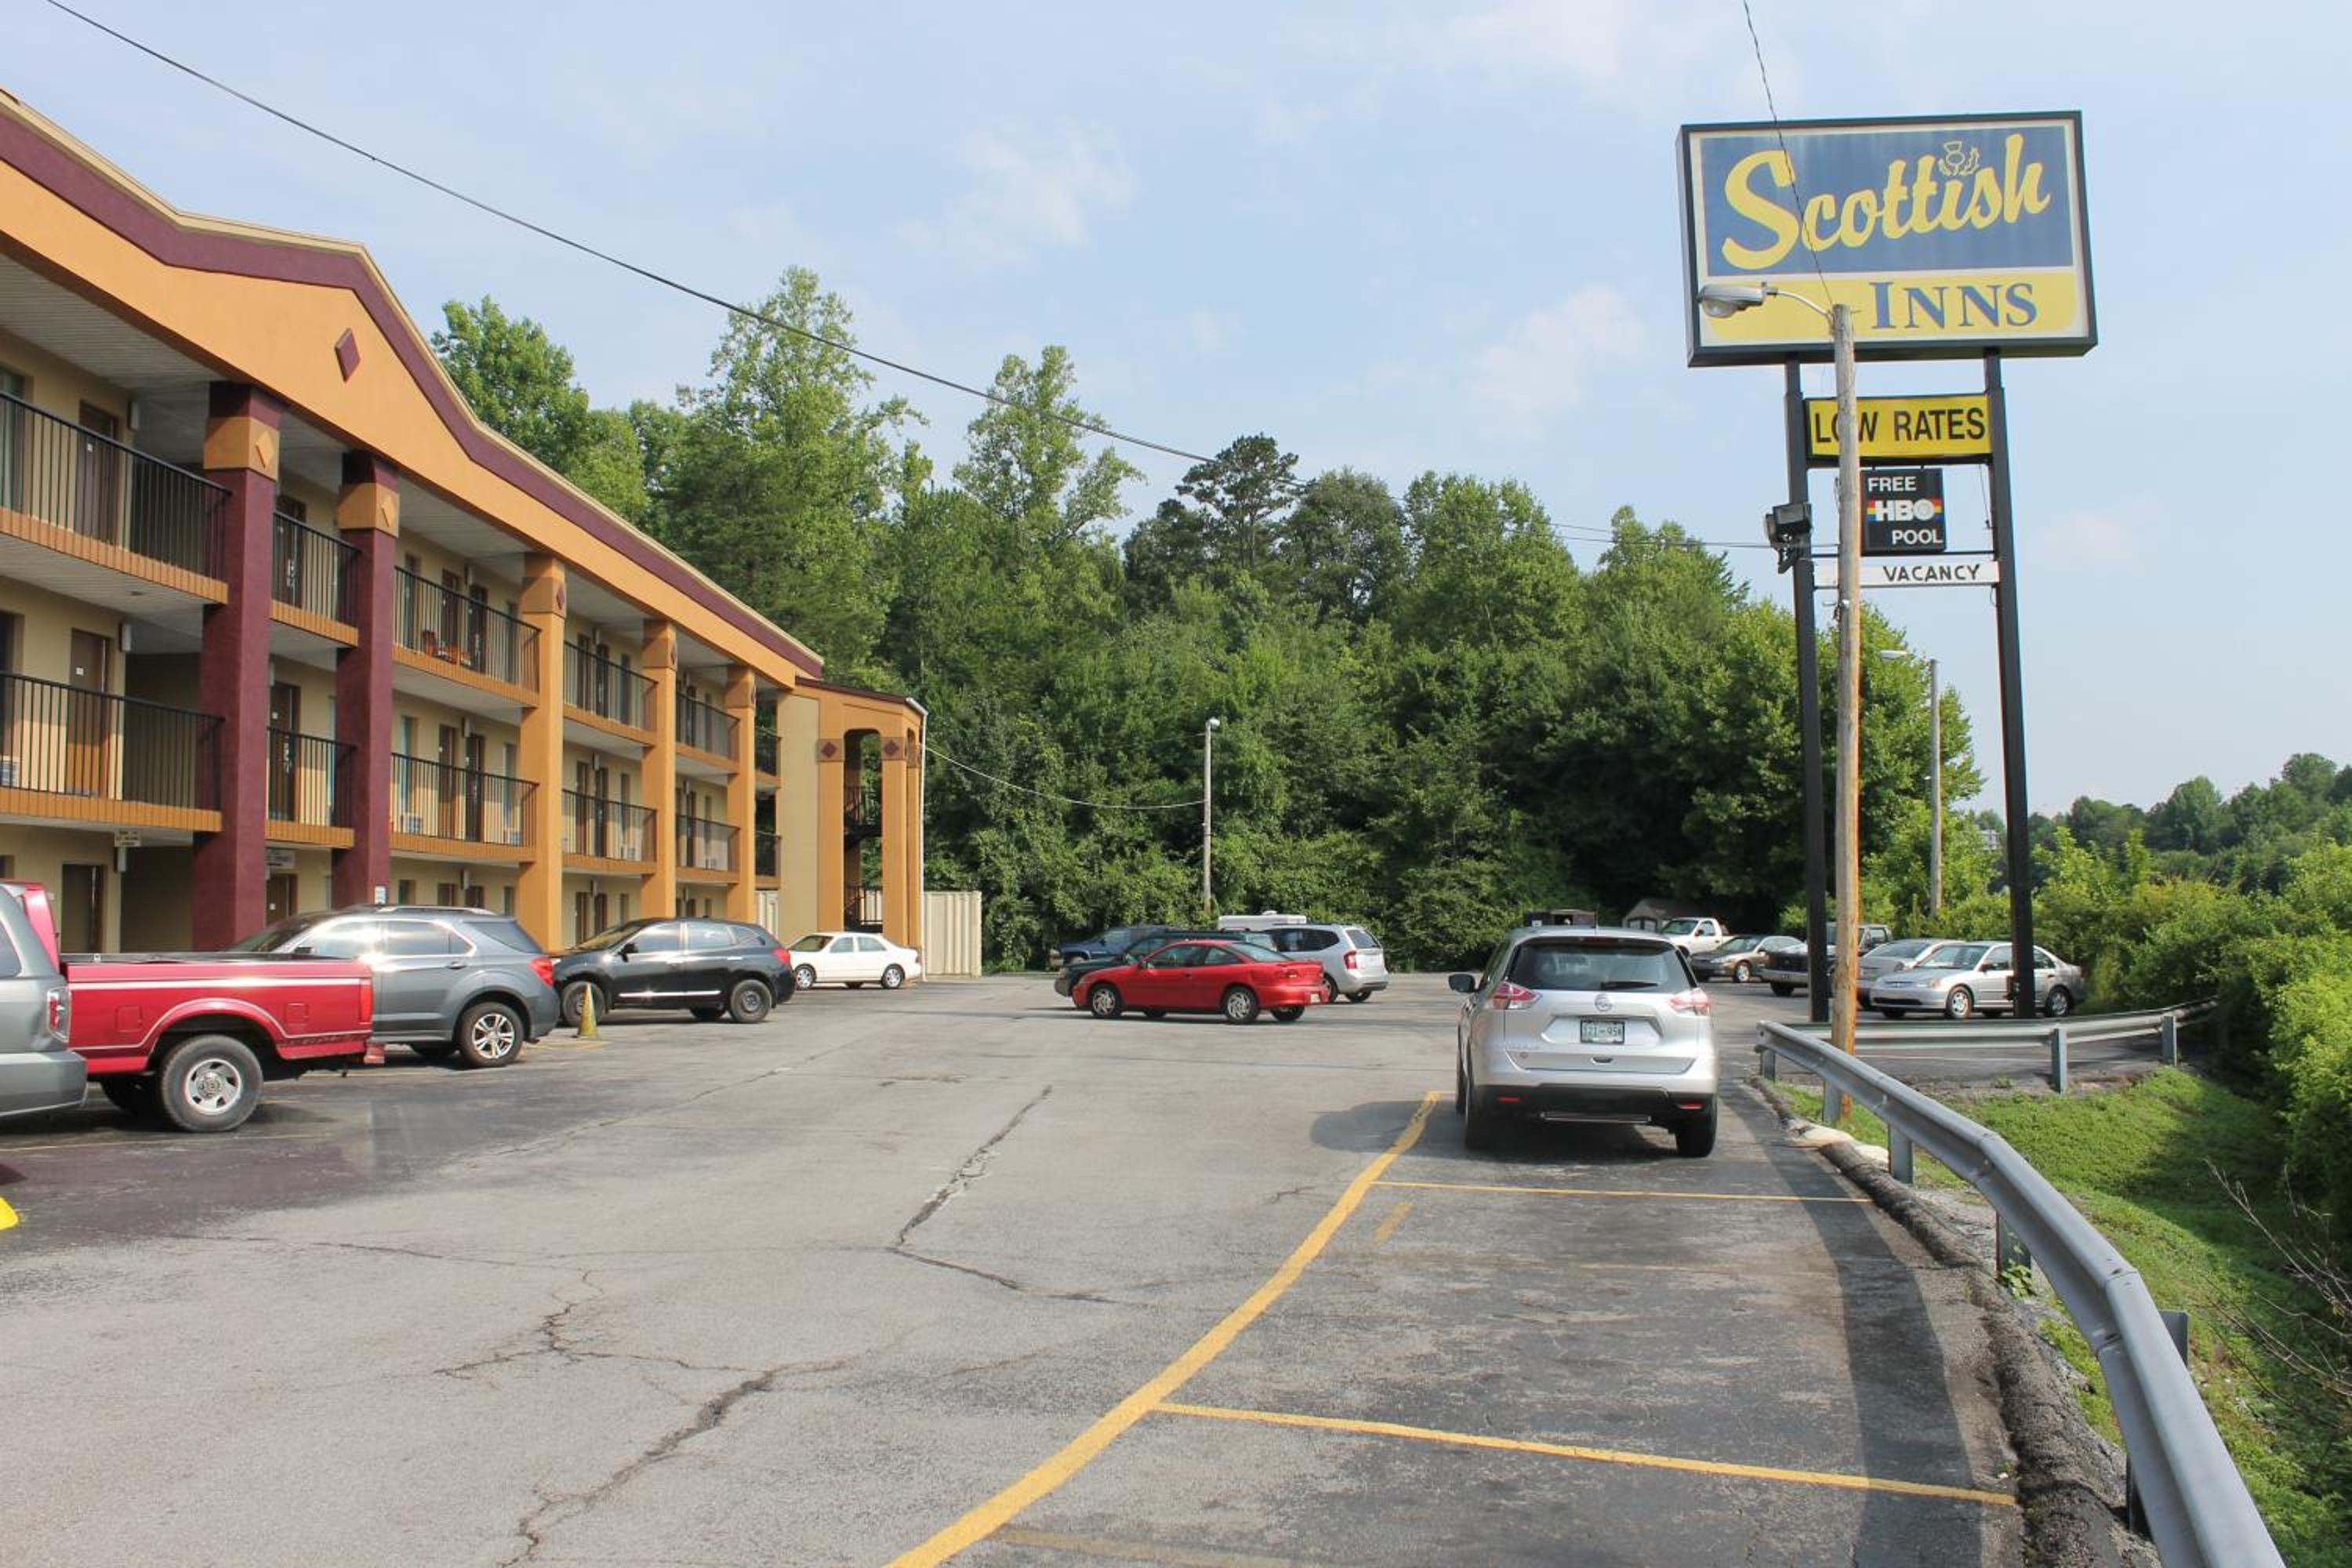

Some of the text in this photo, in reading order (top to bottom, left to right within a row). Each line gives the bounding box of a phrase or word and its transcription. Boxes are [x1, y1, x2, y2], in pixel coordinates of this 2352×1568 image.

[1721, 133, 2051, 270] Scottish
[1869, 281, 2038, 329] INNS
[1893, 407, 1986, 442] RATES
[1867, 476, 1918, 492] FREE
[1875, 499, 1934, 521] HBO
[1892, 529, 1944, 545] POOL
[1883, 564, 1980, 582] VACANCY
